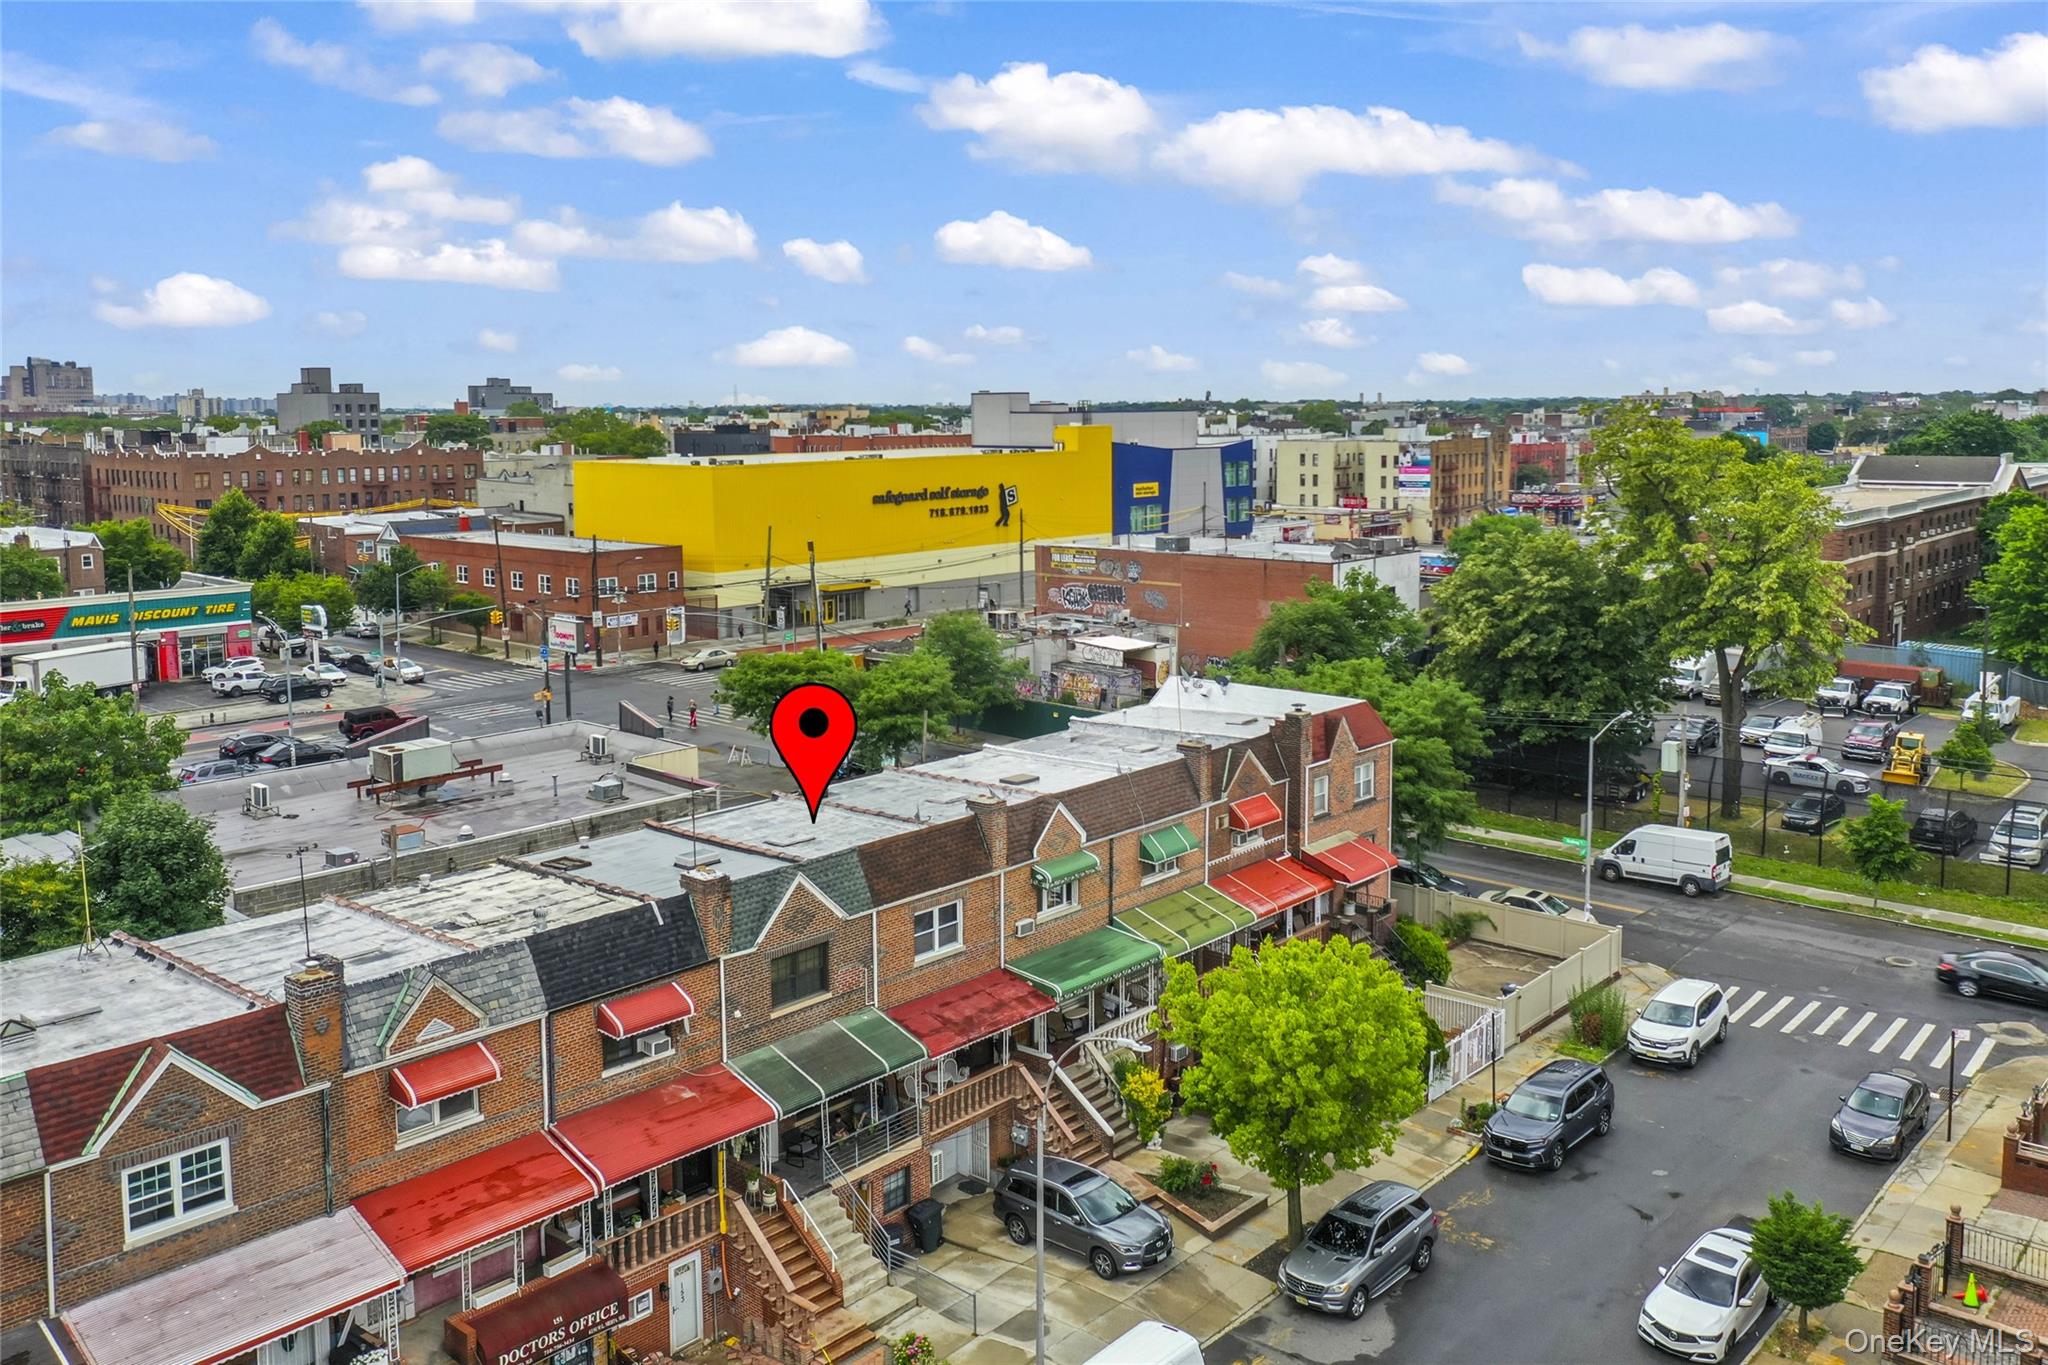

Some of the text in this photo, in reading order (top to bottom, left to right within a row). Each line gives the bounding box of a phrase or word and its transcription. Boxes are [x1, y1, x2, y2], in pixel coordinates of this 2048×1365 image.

[929, 487, 951, 500] self
[1007, 490, 1015, 502] S
[71, 614, 120, 628] MAVIS
[205, 602, 236, 615] TIRE
[22, 621, 45, 630] brake
[554, 631, 575, 641] DONUTS
[498, 1326, 566, 1365] DOCTORS
[569, 1302, 619, 1335] OFFICE
